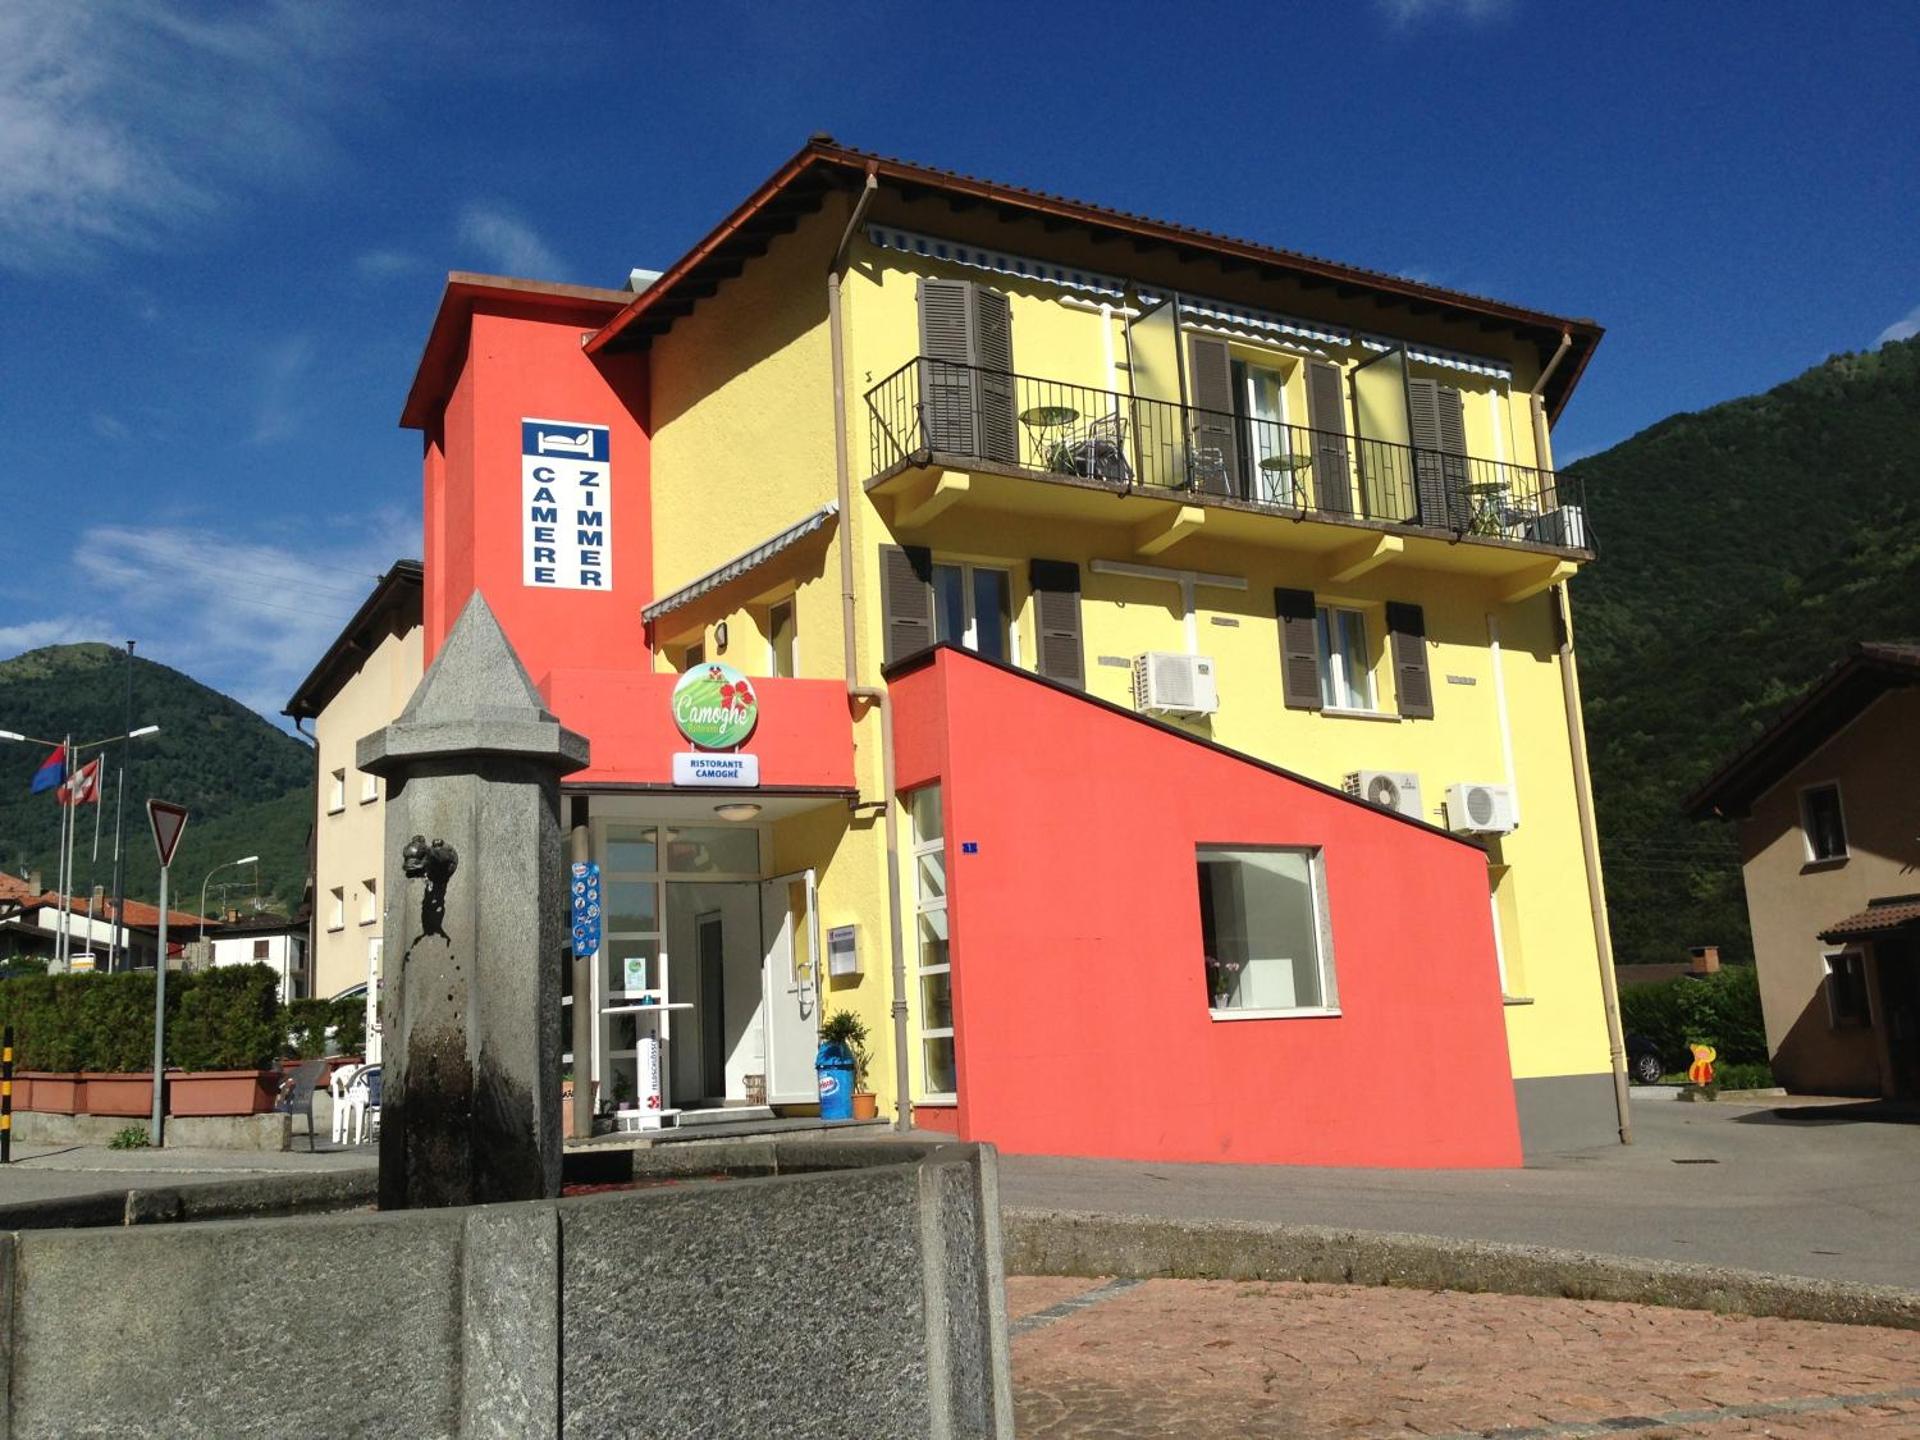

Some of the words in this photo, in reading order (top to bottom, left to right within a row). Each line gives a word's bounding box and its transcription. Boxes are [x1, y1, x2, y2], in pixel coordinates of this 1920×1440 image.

[531, 467, 557, 583] CAMERE
[577, 471, 603, 586] ZIMMER
[690, 759, 743, 769] RISTORANTE
